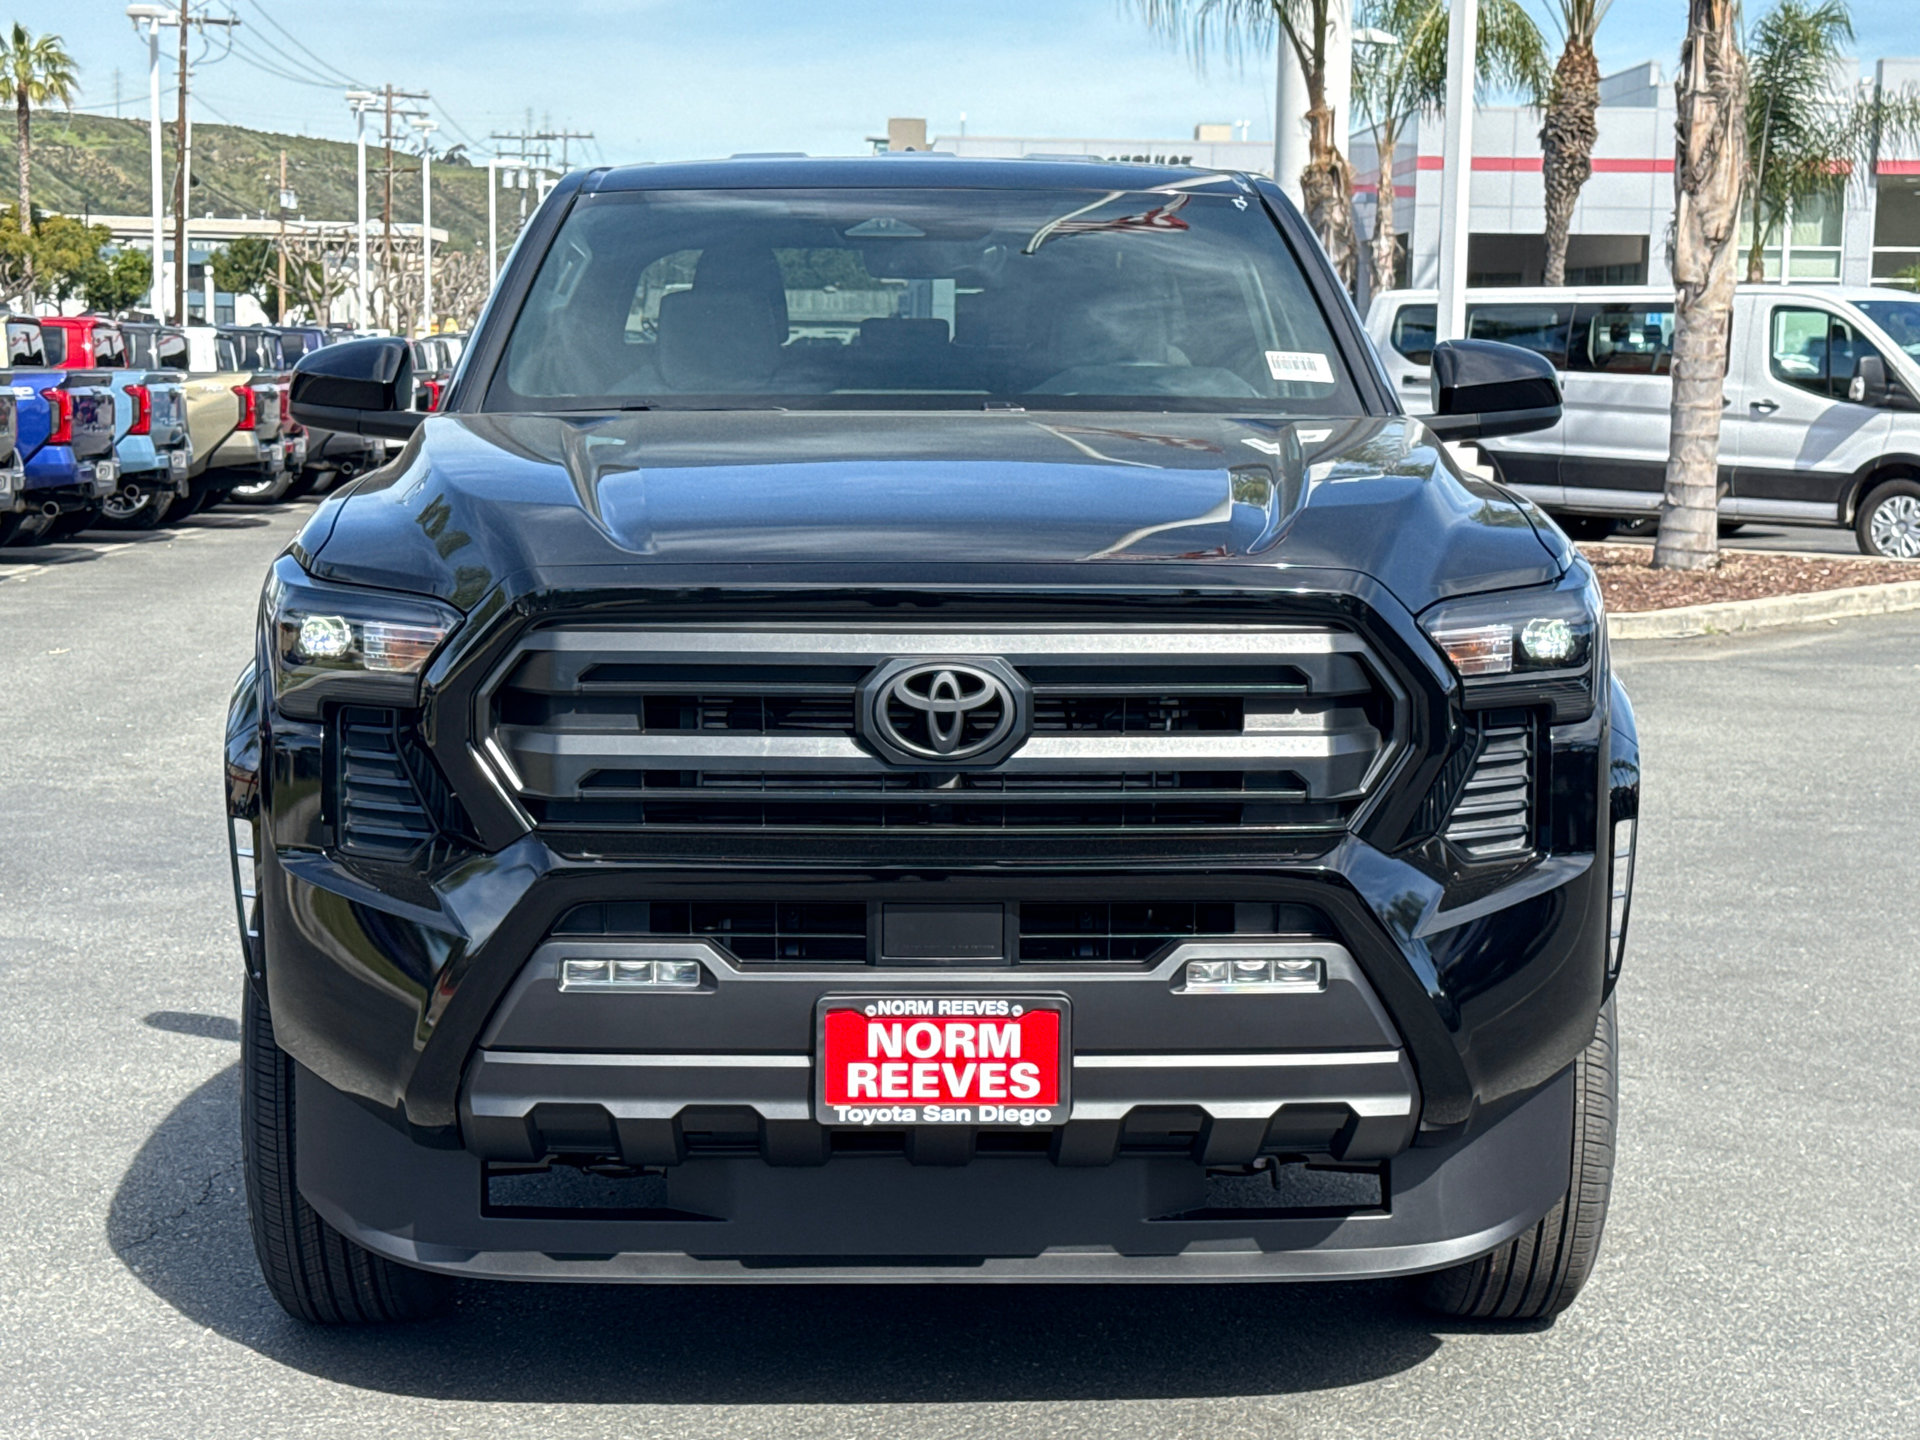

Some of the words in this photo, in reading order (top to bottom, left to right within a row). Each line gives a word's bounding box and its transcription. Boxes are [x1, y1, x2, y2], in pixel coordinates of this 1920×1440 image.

[878, 1000, 933, 1015] NORM
[938, 1000, 1009, 1016] REEVES
[868, 1022, 1021, 1058] NORM
[847, 1062, 1041, 1099] REEVES
[833, 1105, 918, 1125] Toyota
[923, 1106, 971, 1122] San
[979, 1105, 1052, 1125] Diego
